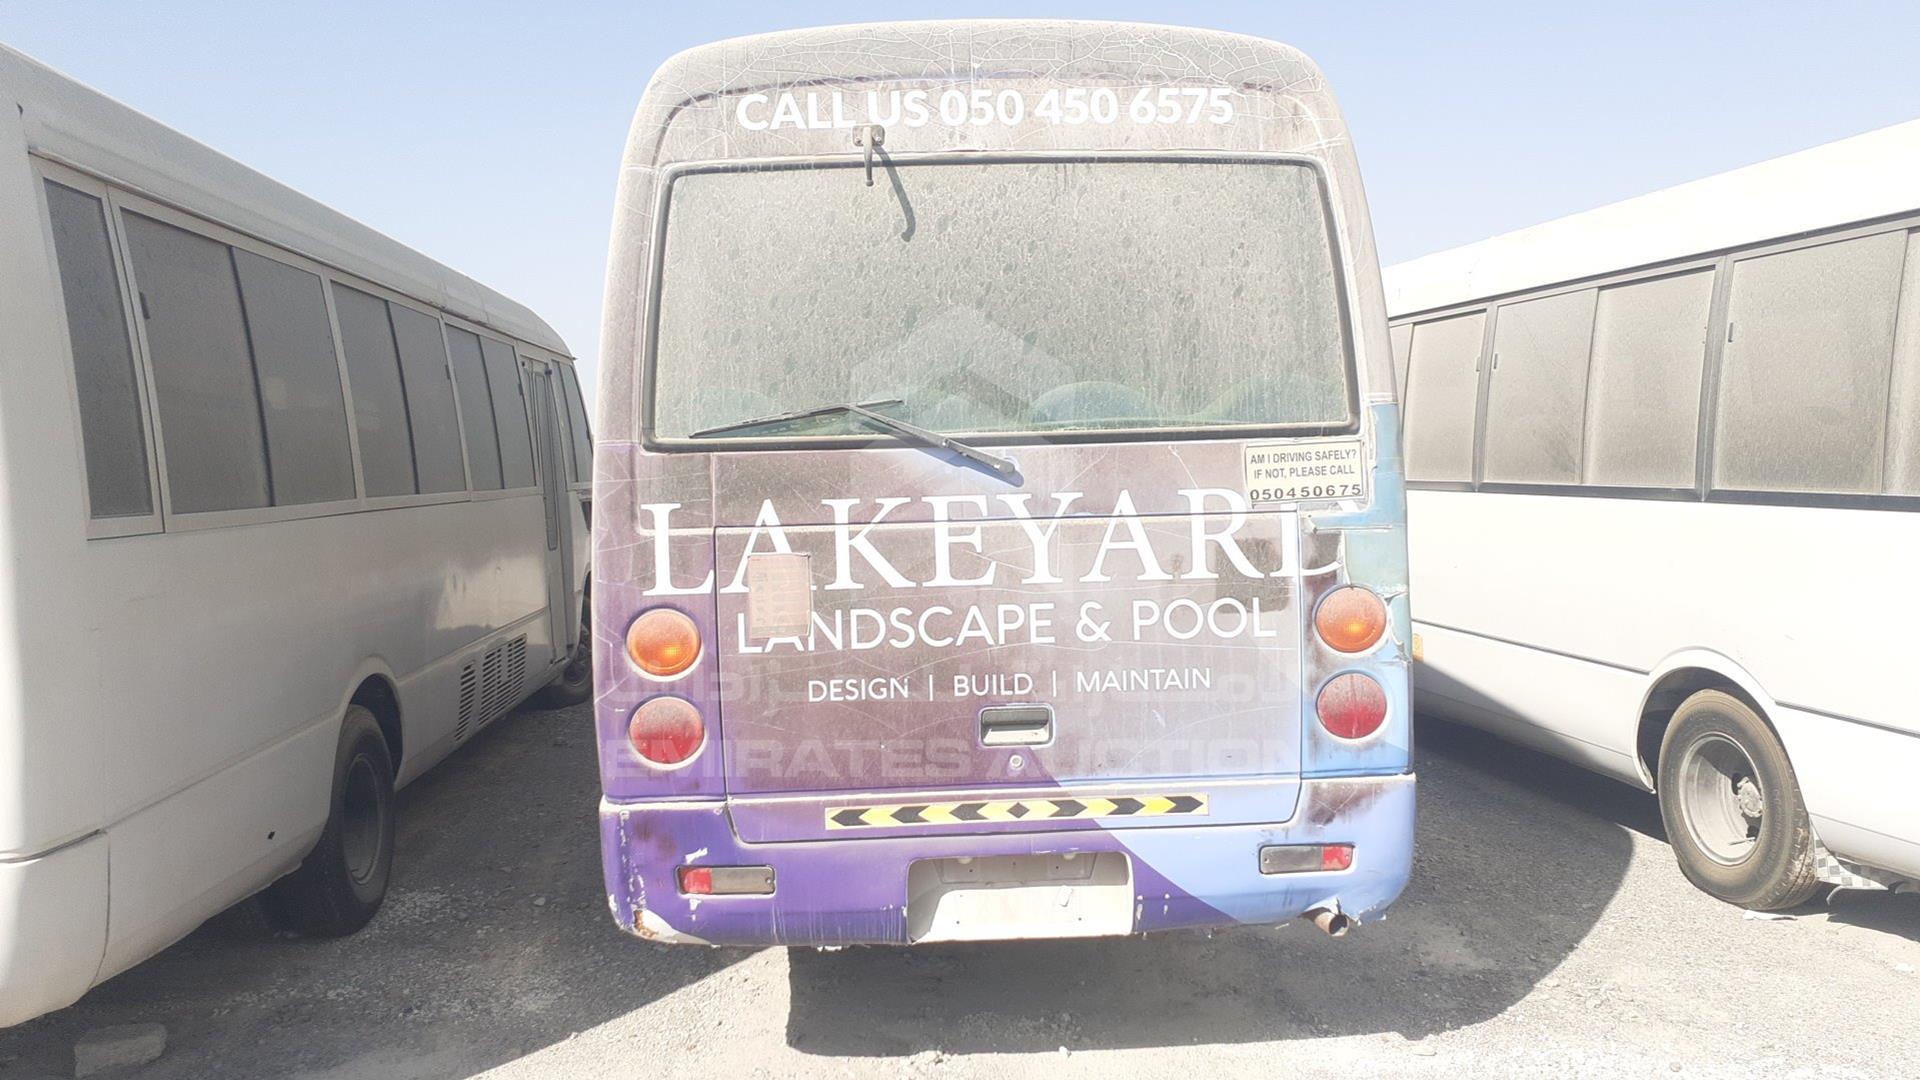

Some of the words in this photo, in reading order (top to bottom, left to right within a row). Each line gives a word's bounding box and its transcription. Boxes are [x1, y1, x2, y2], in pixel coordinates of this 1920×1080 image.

[736, 92, 856, 130] CALL
[869, 88, 930, 128] US
[938, 88, 1025, 126] 050
[1033, 88, 1119, 125] 450
[1128, 87, 1234, 124] 6575
[1250, 453, 1265, 464] AM
[1272, 451, 1313, 463] DRIVING
[1314, 449, 1357, 461] SAFELY?
[1254, 469, 1263, 480] IF
[1265, 467, 1287, 480] NOT,
[1289, 465, 1327, 477] PLEASE
[1329, 464, 1356, 476] CALL
[1250, 484, 1361, 500] 050450675
[1074, 601, 1113, 643] &
[1132, 597, 1277, 641] POOL
[807, 677, 909, 702] DESIGN
[953, 674, 1034, 698] BUILD
[1076, 667, 1211, 693] MAINTAIN
